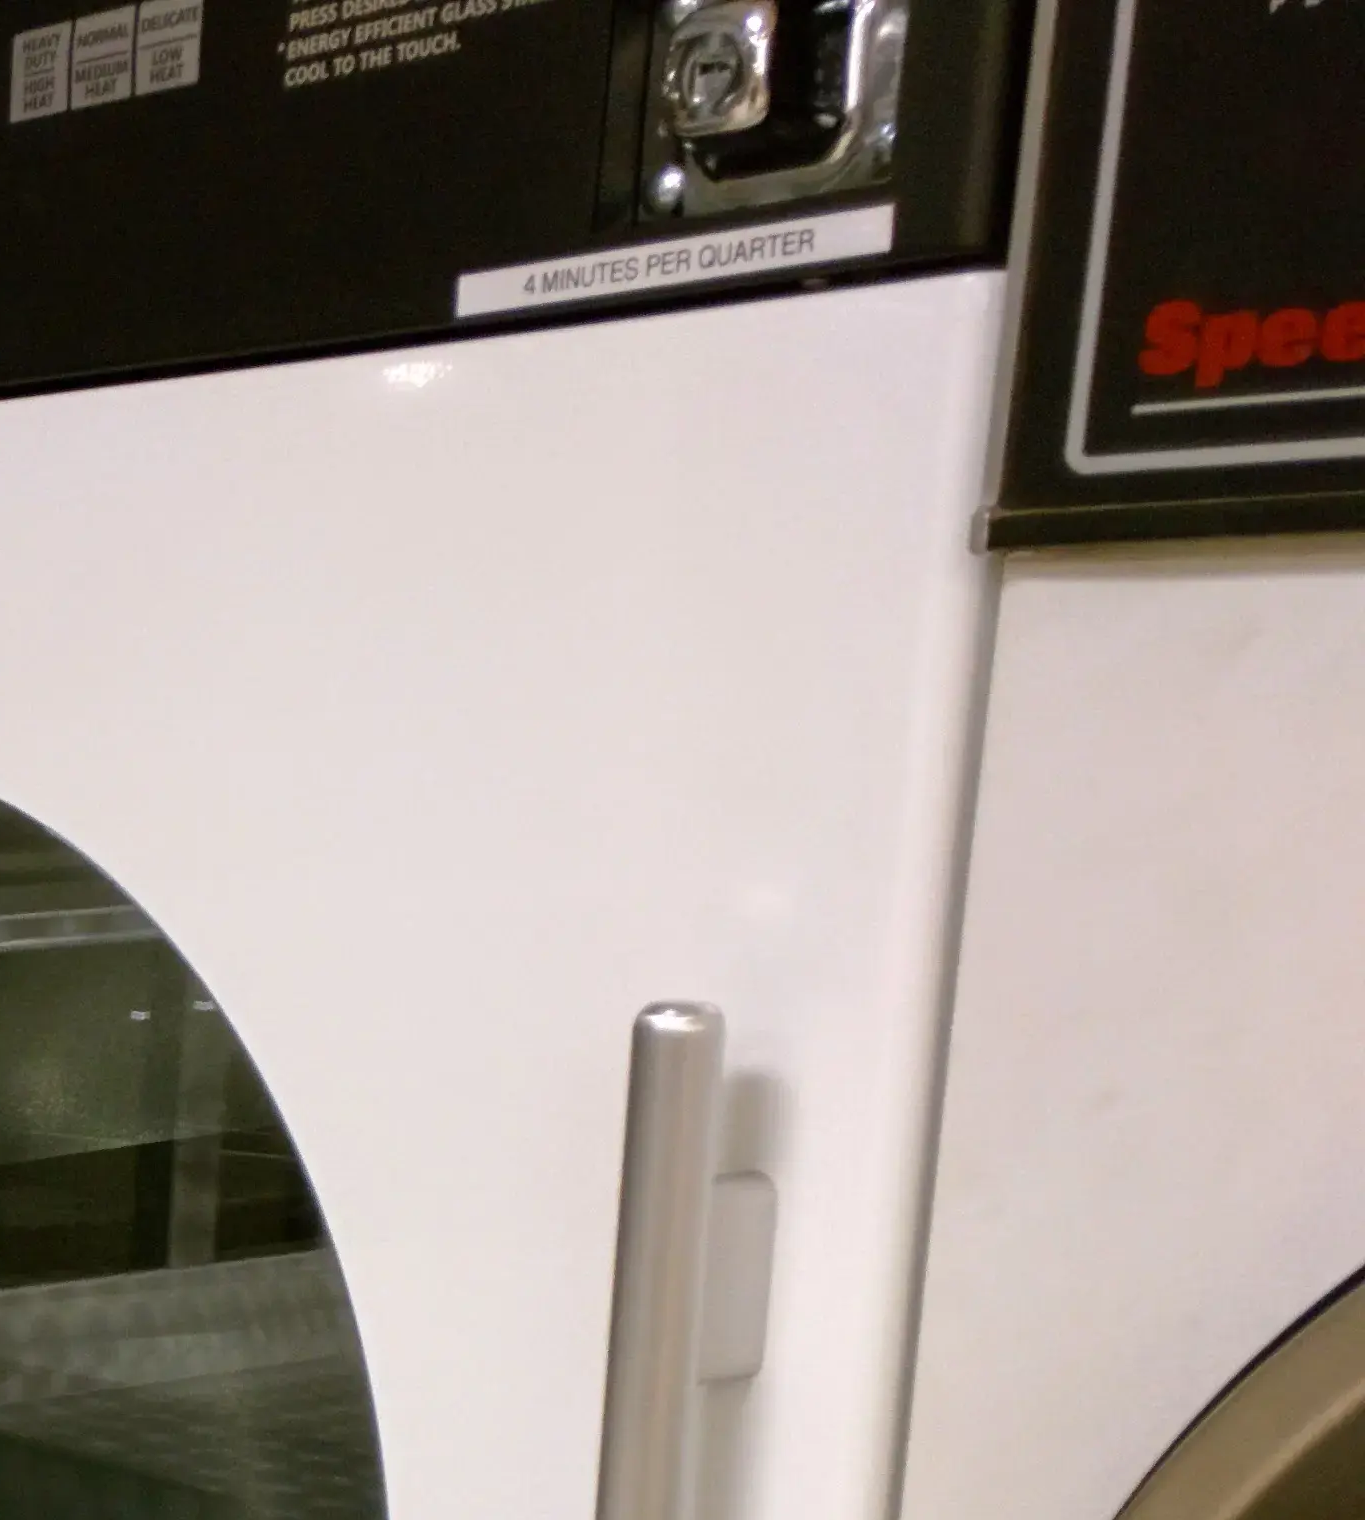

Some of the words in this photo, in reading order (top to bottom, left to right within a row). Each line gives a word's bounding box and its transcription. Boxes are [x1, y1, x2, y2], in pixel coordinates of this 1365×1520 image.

[143, 8, 197, 32] DELICATE
[290, 4, 338, 31] PRESS
[78, 24, 128, 47] NORMAL
[288, 28, 351, 59] ENERGY
[354, 8, 437, 44] EFFICIENT
[23, 35, 61, 53] HEAVY
[25, 52, 55, 67] DUTY
[153, 48, 183, 65] LOW
[285, 61, 329, 86] COOL
[334, 55, 355, 75] TO
[360, 47, 393, 71] THE
[397, 33, 461, 62] TOUCH.
[75, 62, 129, 83] MEDIUM
[151, 66, 183, 83] HEAT
[25, 76, 55, 94] HIGH
[85, 79, 117, 98] HEAT
[24, 94, 54, 112] HEAT
[523, 274, 536, 295] 4
[542, 259, 638, 294] MINUTES
[646, 249, 691, 277] PER
[699, 230, 815, 270] QUARTER
